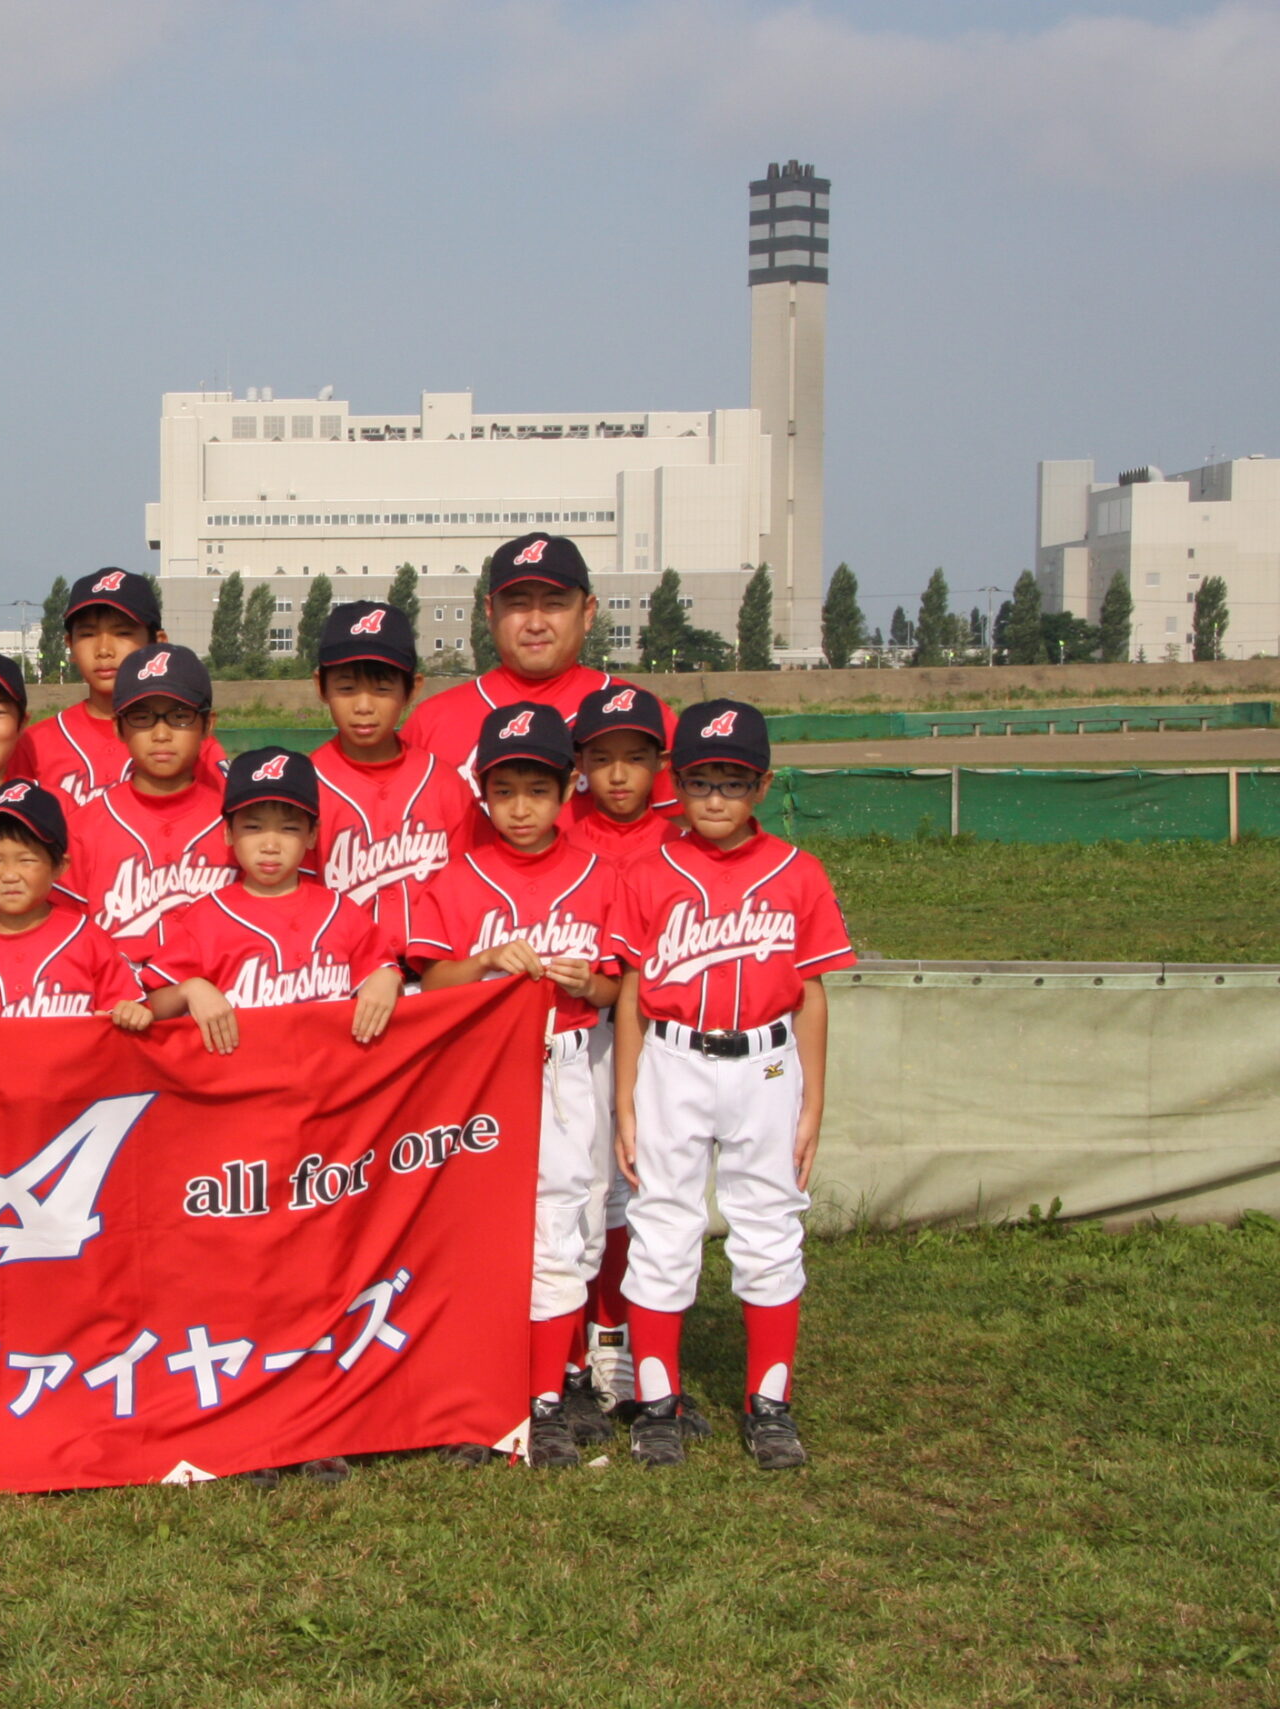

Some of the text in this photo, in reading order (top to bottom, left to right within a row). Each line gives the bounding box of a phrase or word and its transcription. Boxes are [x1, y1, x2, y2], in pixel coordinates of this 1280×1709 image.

[513, 540, 548, 565] A
[92, 571, 126, 593] A
[351, 609, 387, 635] A
[137, 652, 171, 680] A
[602, 689, 636, 714] A
[499, 711, 535, 739] A
[701, 711, 738, 738] A
[252, 755, 289, 781] A
[324, 820, 449, 893] Akashiya
[95, 853, 237, 931] Akashiya
[644, 898, 795, 981] Akashiya
[183, 1113, 500, 1217] all for one
